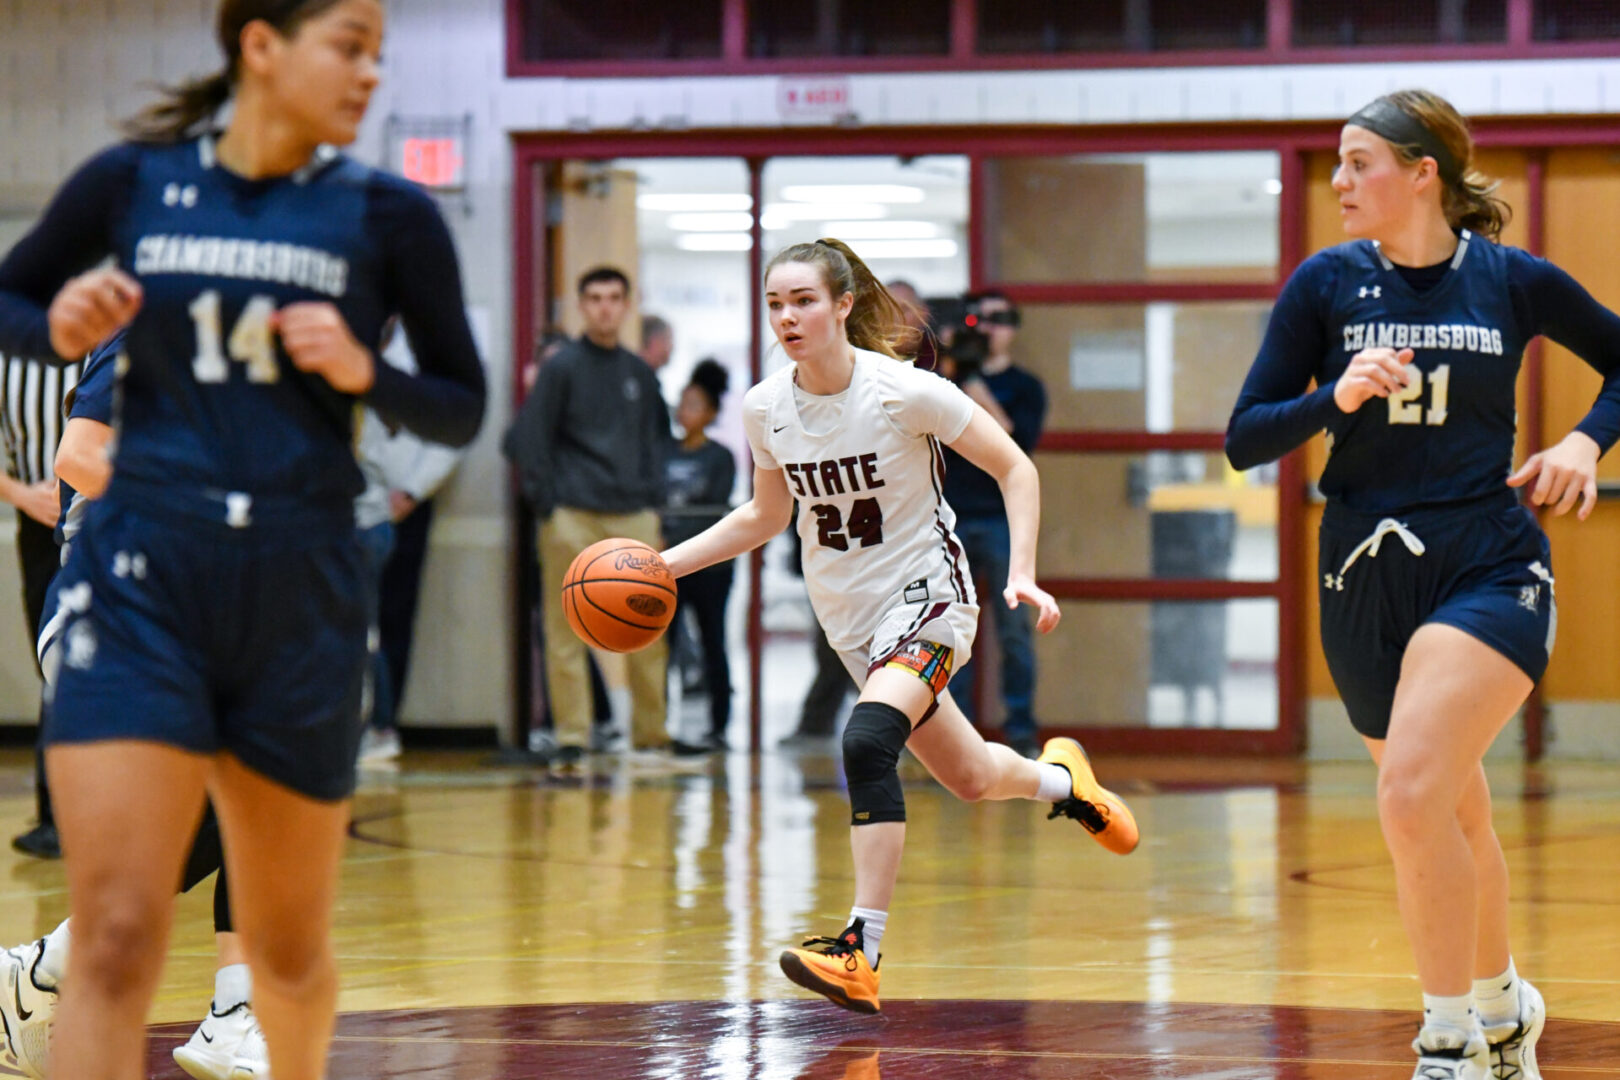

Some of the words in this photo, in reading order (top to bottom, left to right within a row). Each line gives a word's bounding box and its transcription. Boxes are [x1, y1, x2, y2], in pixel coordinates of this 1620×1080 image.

[135, 234, 347, 297] CHAMBERSBURG
[189, 289, 279, 383] 14
[1344, 322, 1504, 356] CHAMBERSBURG
[1388, 363, 1450, 425] 21
[785, 452, 886, 497] STATE
[810, 497, 883, 552] 24
